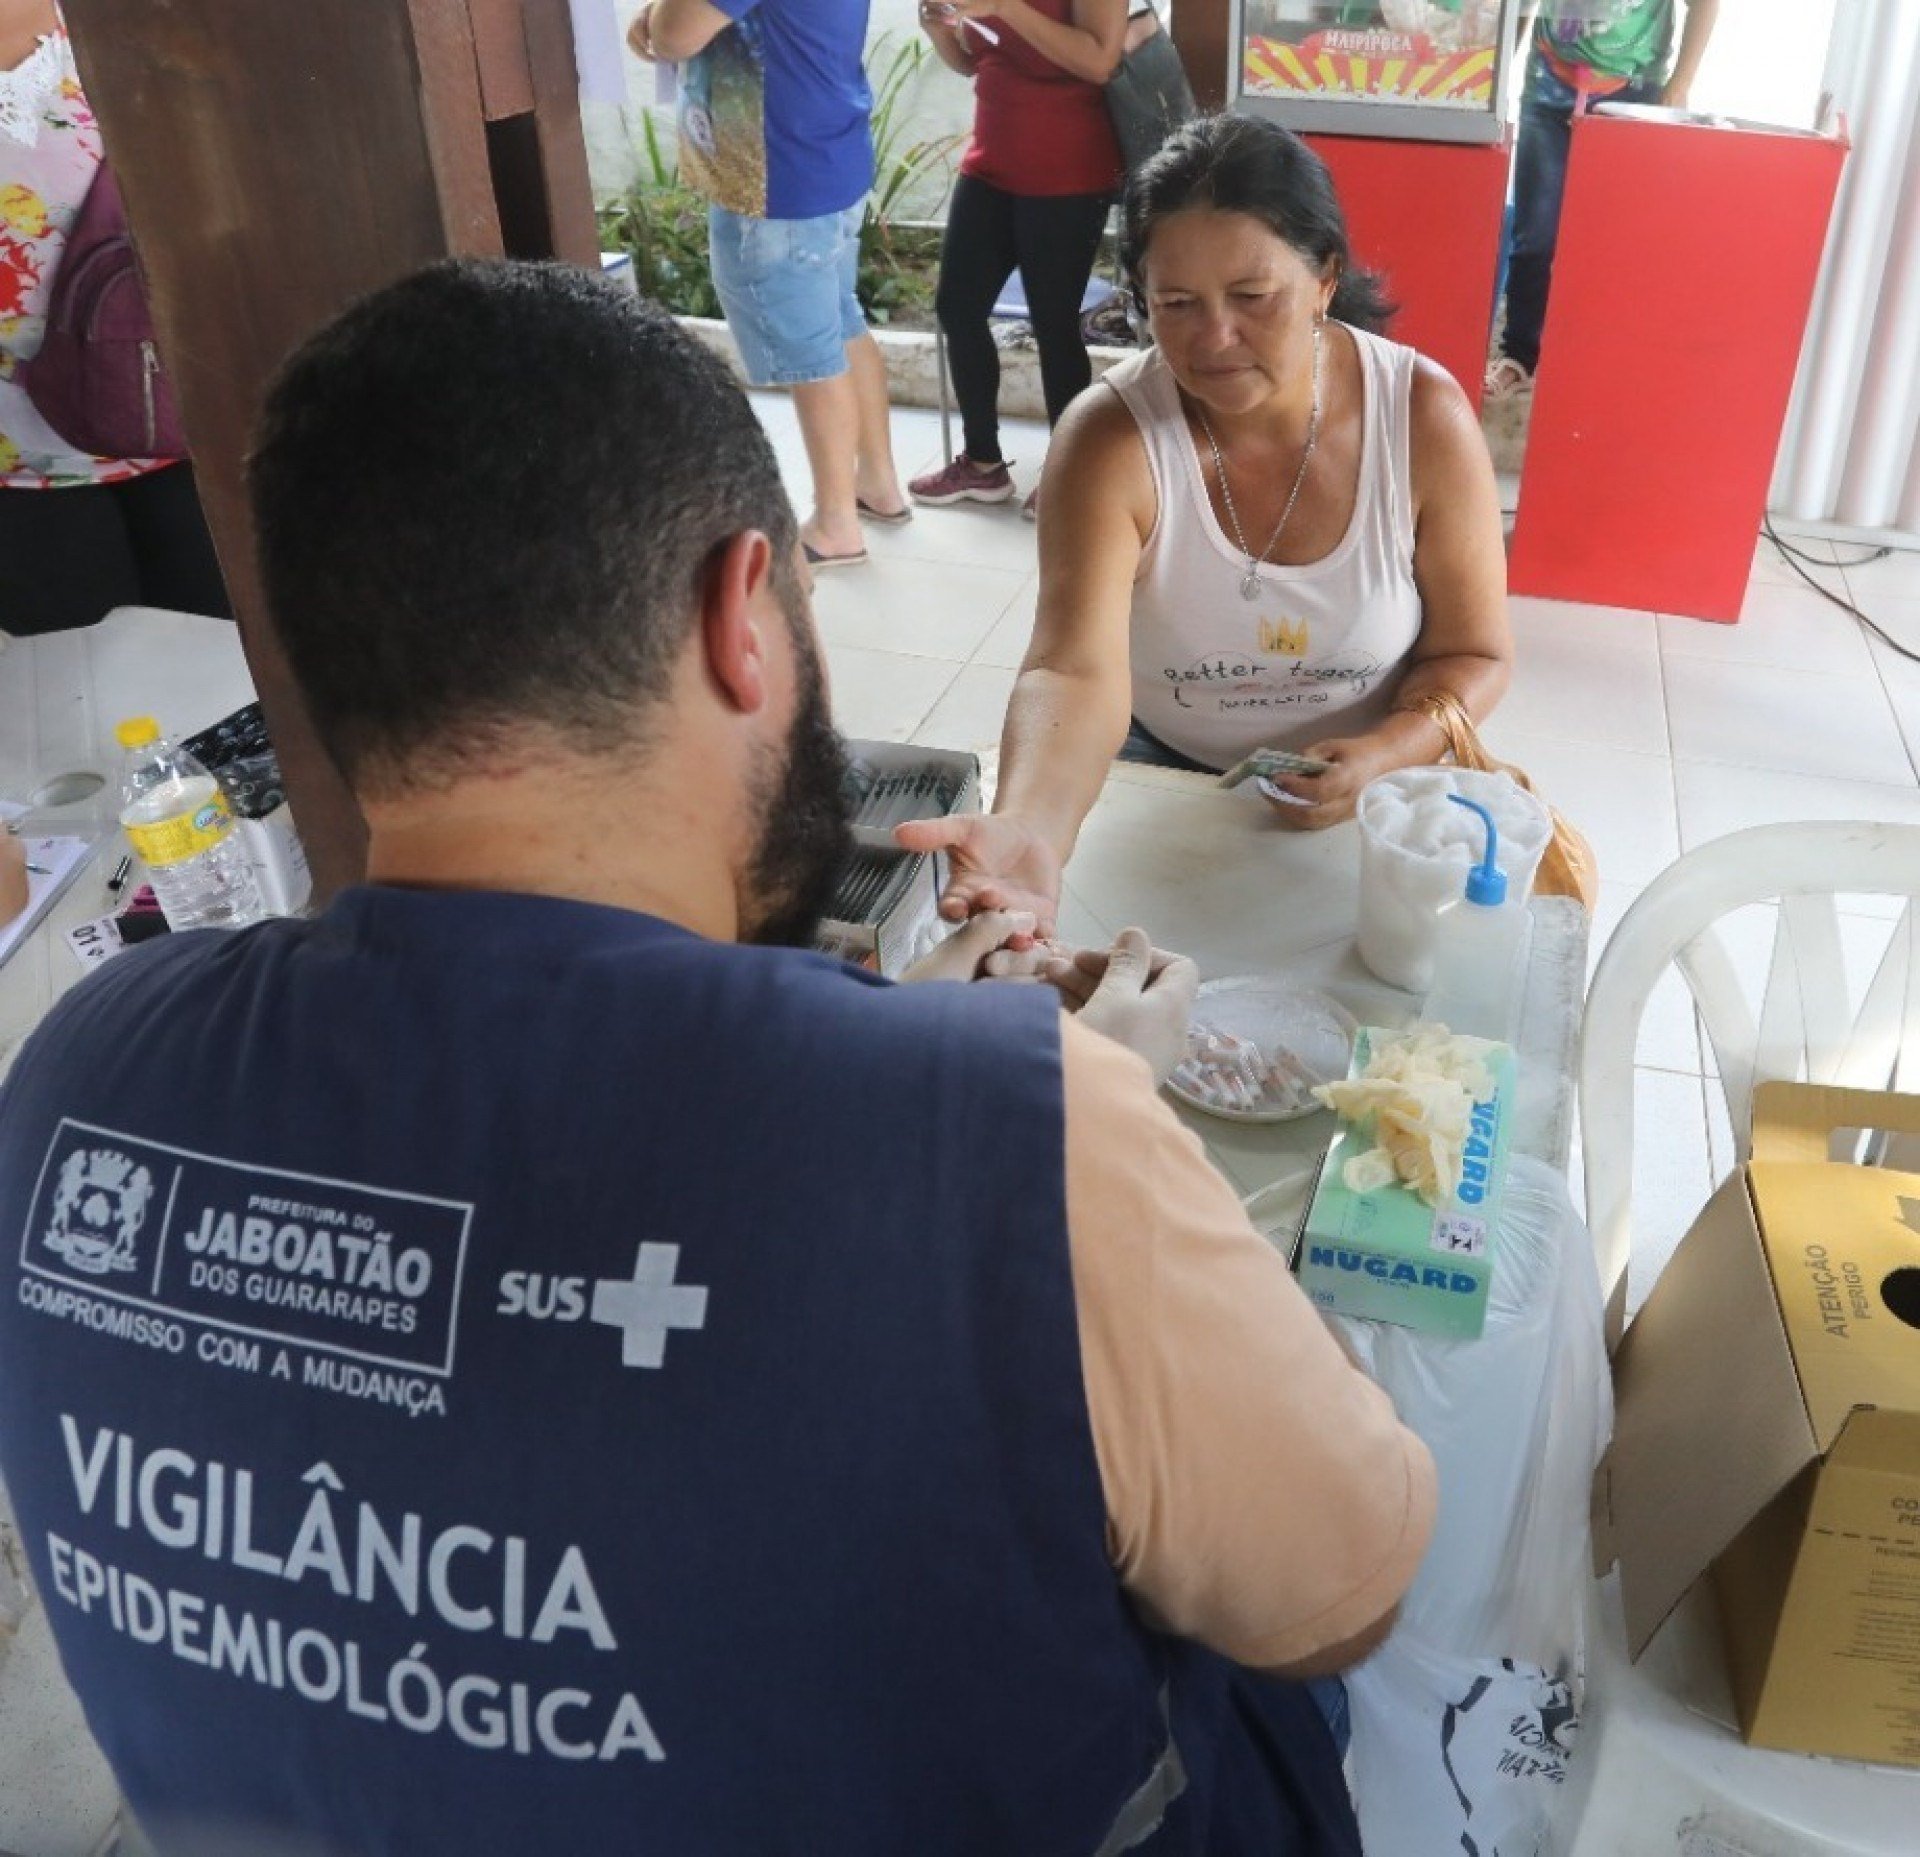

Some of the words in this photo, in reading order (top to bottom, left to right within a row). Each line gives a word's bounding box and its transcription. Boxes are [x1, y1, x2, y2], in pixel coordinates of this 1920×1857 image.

[184, 1207, 432, 1298] JABOATÃO
[247, 1193, 348, 1227] PREFEITURA
[352, 1213, 376, 1232] DO
[189, 1260, 241, 1295] DOS
[245, 1270, 418, 1334] GUARARAPES
[497, 1270, 586, 1322] SUS
[1309, 1245, 1478, 1294] NUGARD
[1804, 1243, 1850, 1340] ATENÇÃO
[1840, 1261, 1873, 1320] PERIGO
[18, 1280, 186, 1354] COMPROMISSO
[197, 1331, 262, 1373] COM
[270, 1350, 291, 1380] A
[304, 1360, 447, 1418] MUDANÇA
[59, 1412, 618, 1652] VIGILÂNCIA
[46, 1529, 667, 1762] EPIDEMIOLÓGICA
